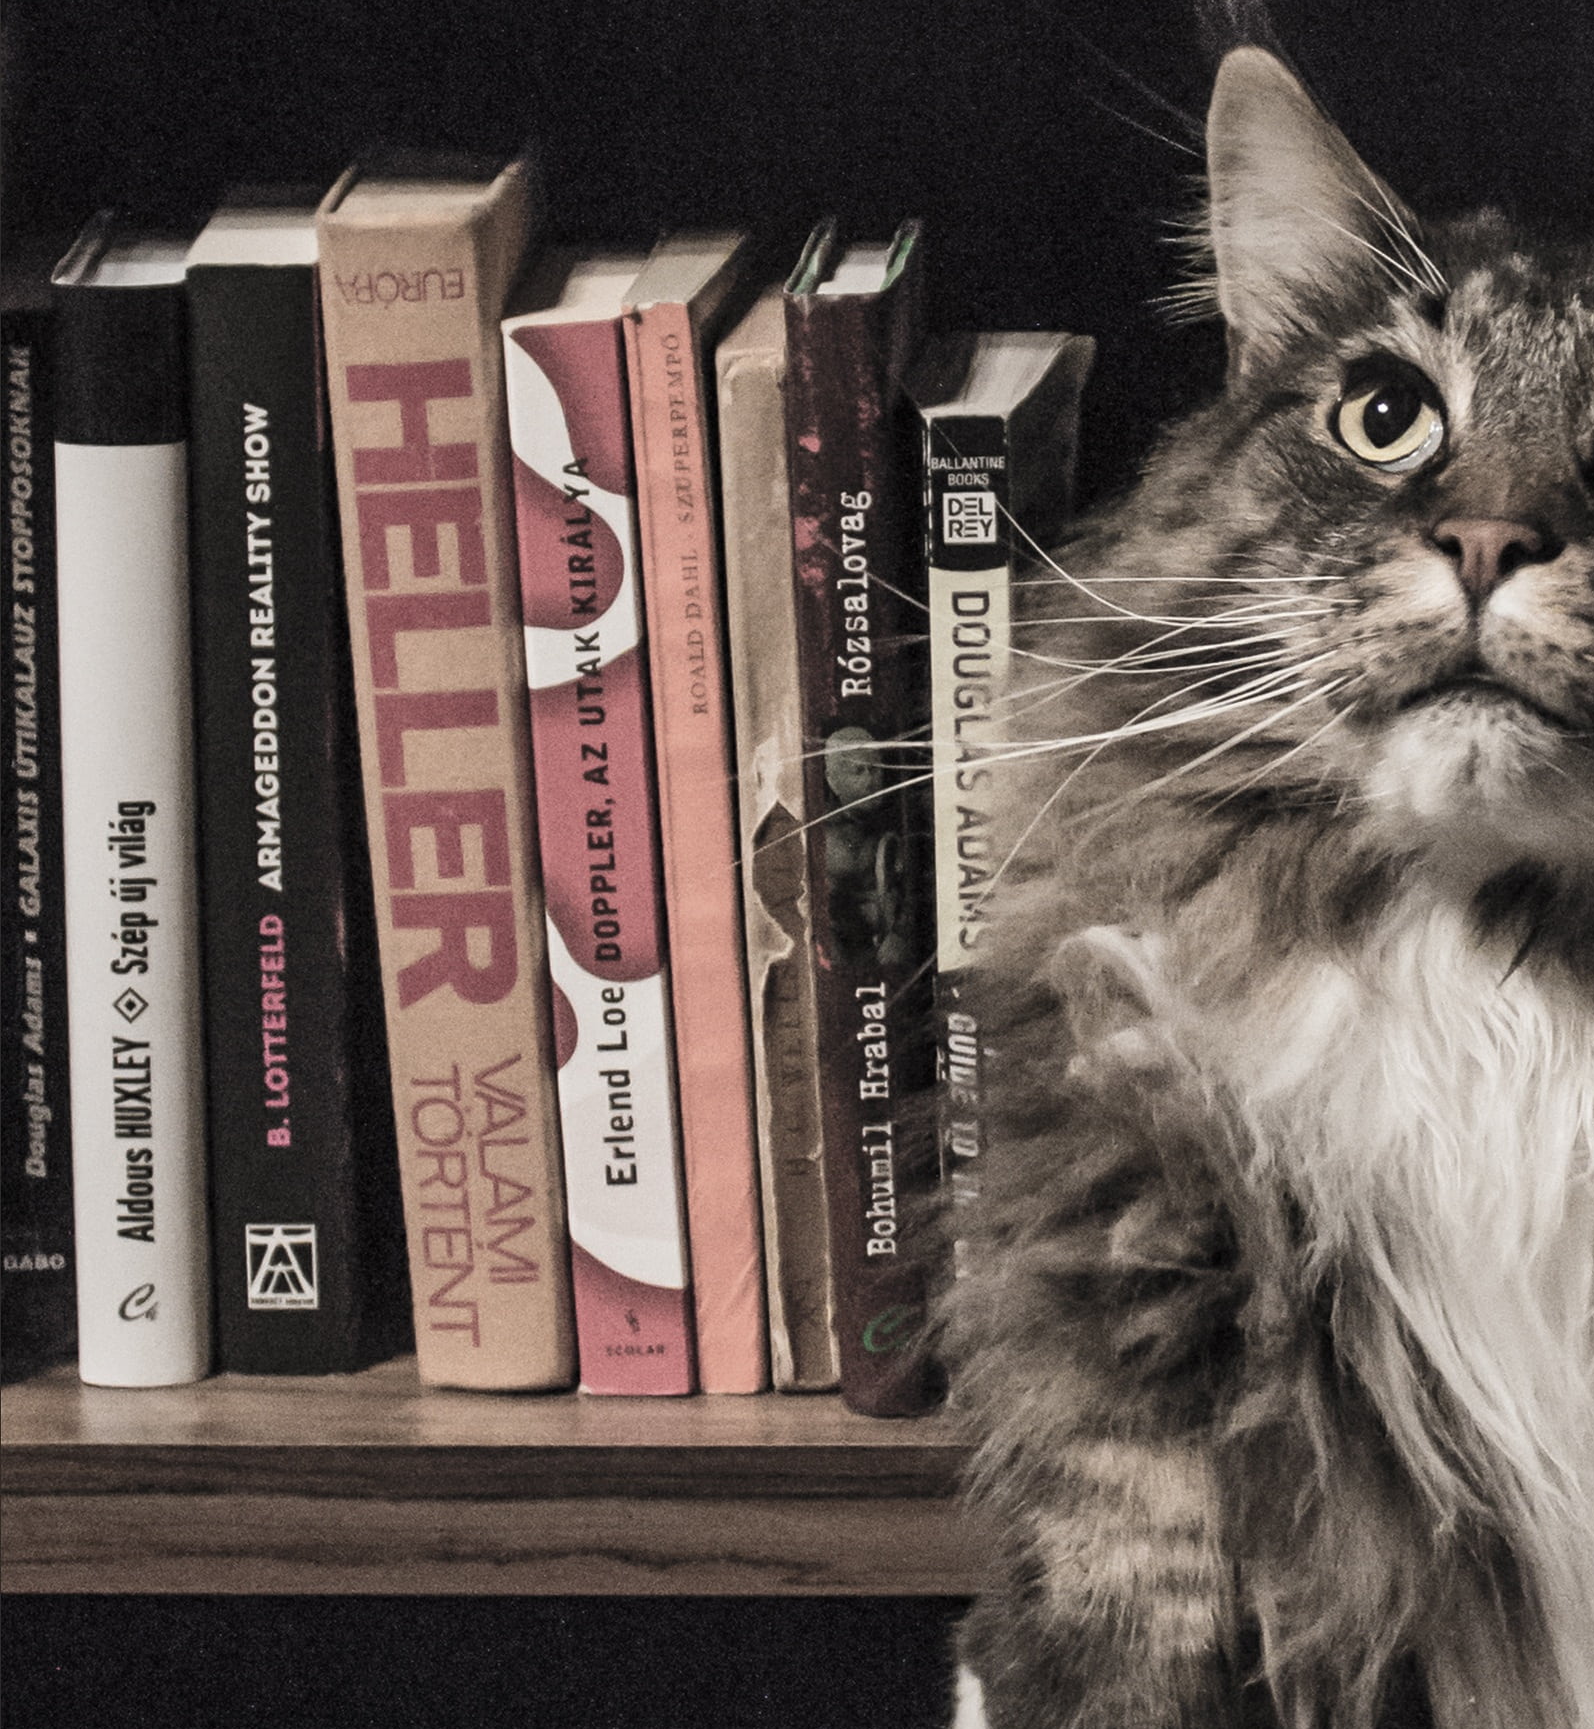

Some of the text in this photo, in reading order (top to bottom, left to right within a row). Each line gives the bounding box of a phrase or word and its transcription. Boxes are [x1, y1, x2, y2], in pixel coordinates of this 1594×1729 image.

[334, 270, 466, 306] EURÓPA
[930, 455, 1006, 471] BALLANTINE
[946, 498, 993, 518] DEL
[946, 519, 996, 539] REY
[947, 472, 990, 488] BOOKS
[344, 357, 519, 1012] HELLER
[681, 550, 710, 717] ROALD DAHL
[14, 788, 41, 918] GALAXIS
[242, 402, 292, 1147] B. LOTTERFELD ARMAGEDDON REALITY SHOW
[561, 456, 640, 1189] Erlend Loe AZ UTAK KIRÁLYA
[950, 589, 993, 952] DOUGLAS ADAMS
[828, 490, 897, 1258] Bohumil Hrabal Rózsalovag
[106, 799, 159, 1244] Aldous HUXLEY Szép új világ
[471, 1051, 541, 1287] VALAMI
